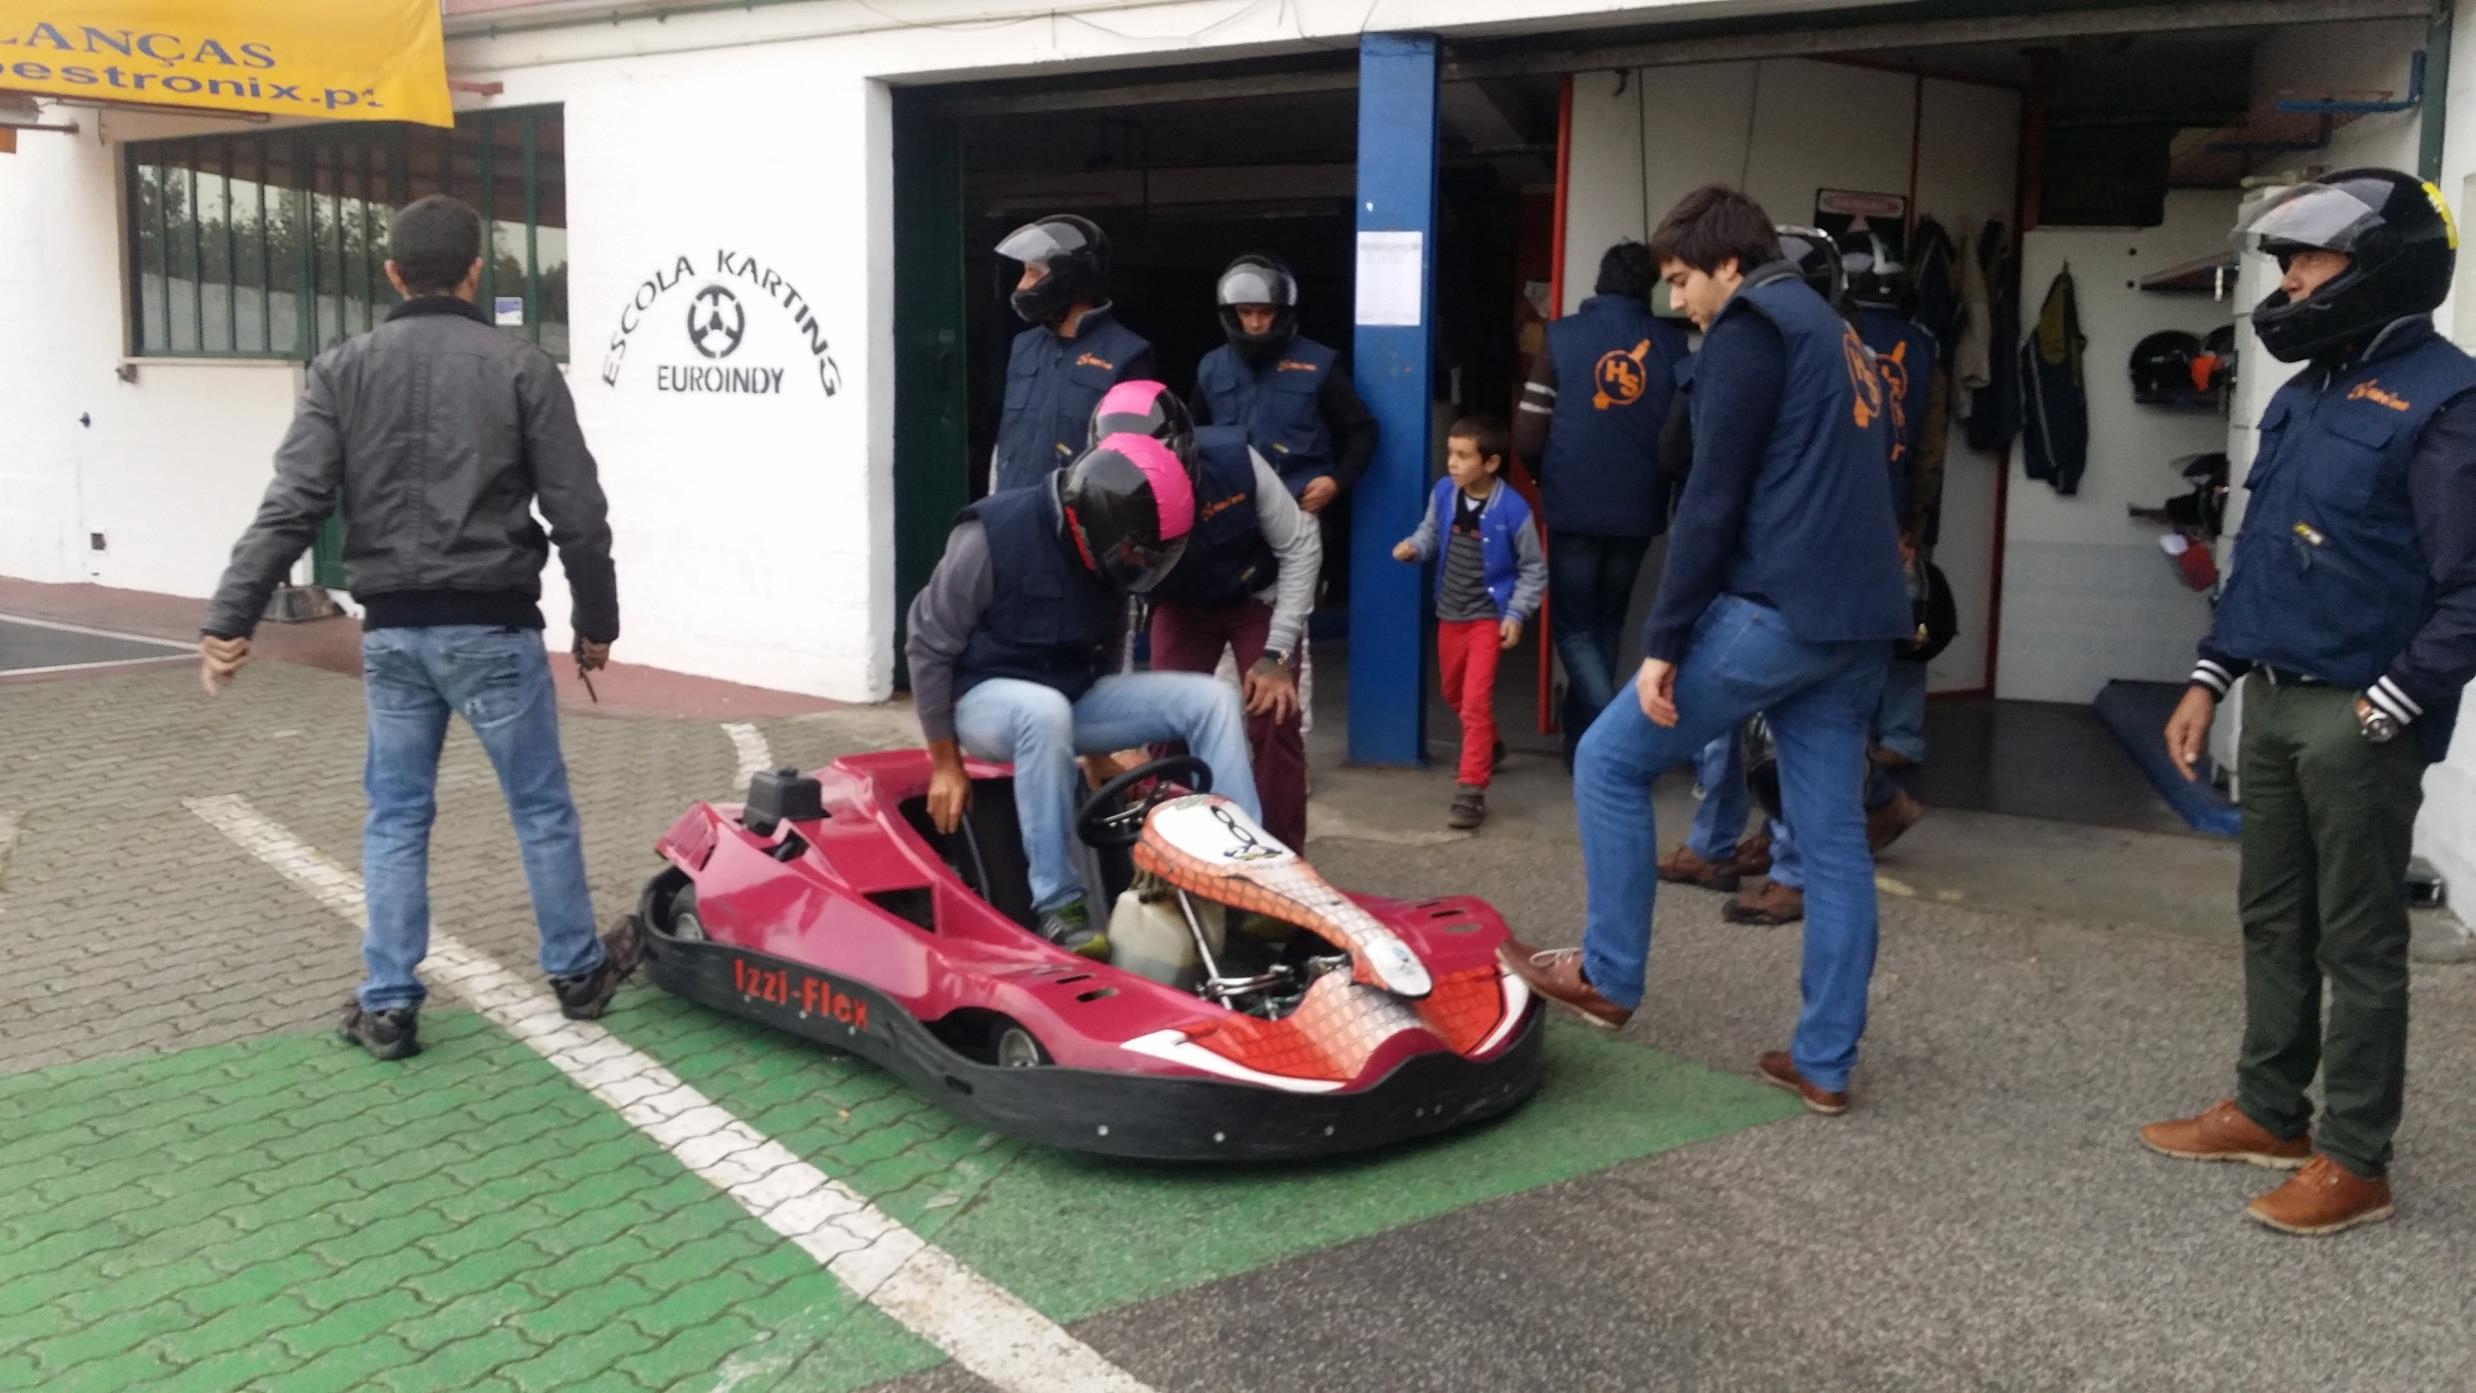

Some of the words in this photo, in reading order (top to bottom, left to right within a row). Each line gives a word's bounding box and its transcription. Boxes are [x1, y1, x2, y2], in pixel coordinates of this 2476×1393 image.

[0, 60, 384, 109] estronix.p
[602, 255, 695, 388] ESCOLA
[717, 249, 842, 397] KARTING
[657, 365, 784, 394] EUROINDY
[733, 957, 869, 1034] Izzi-Flex
